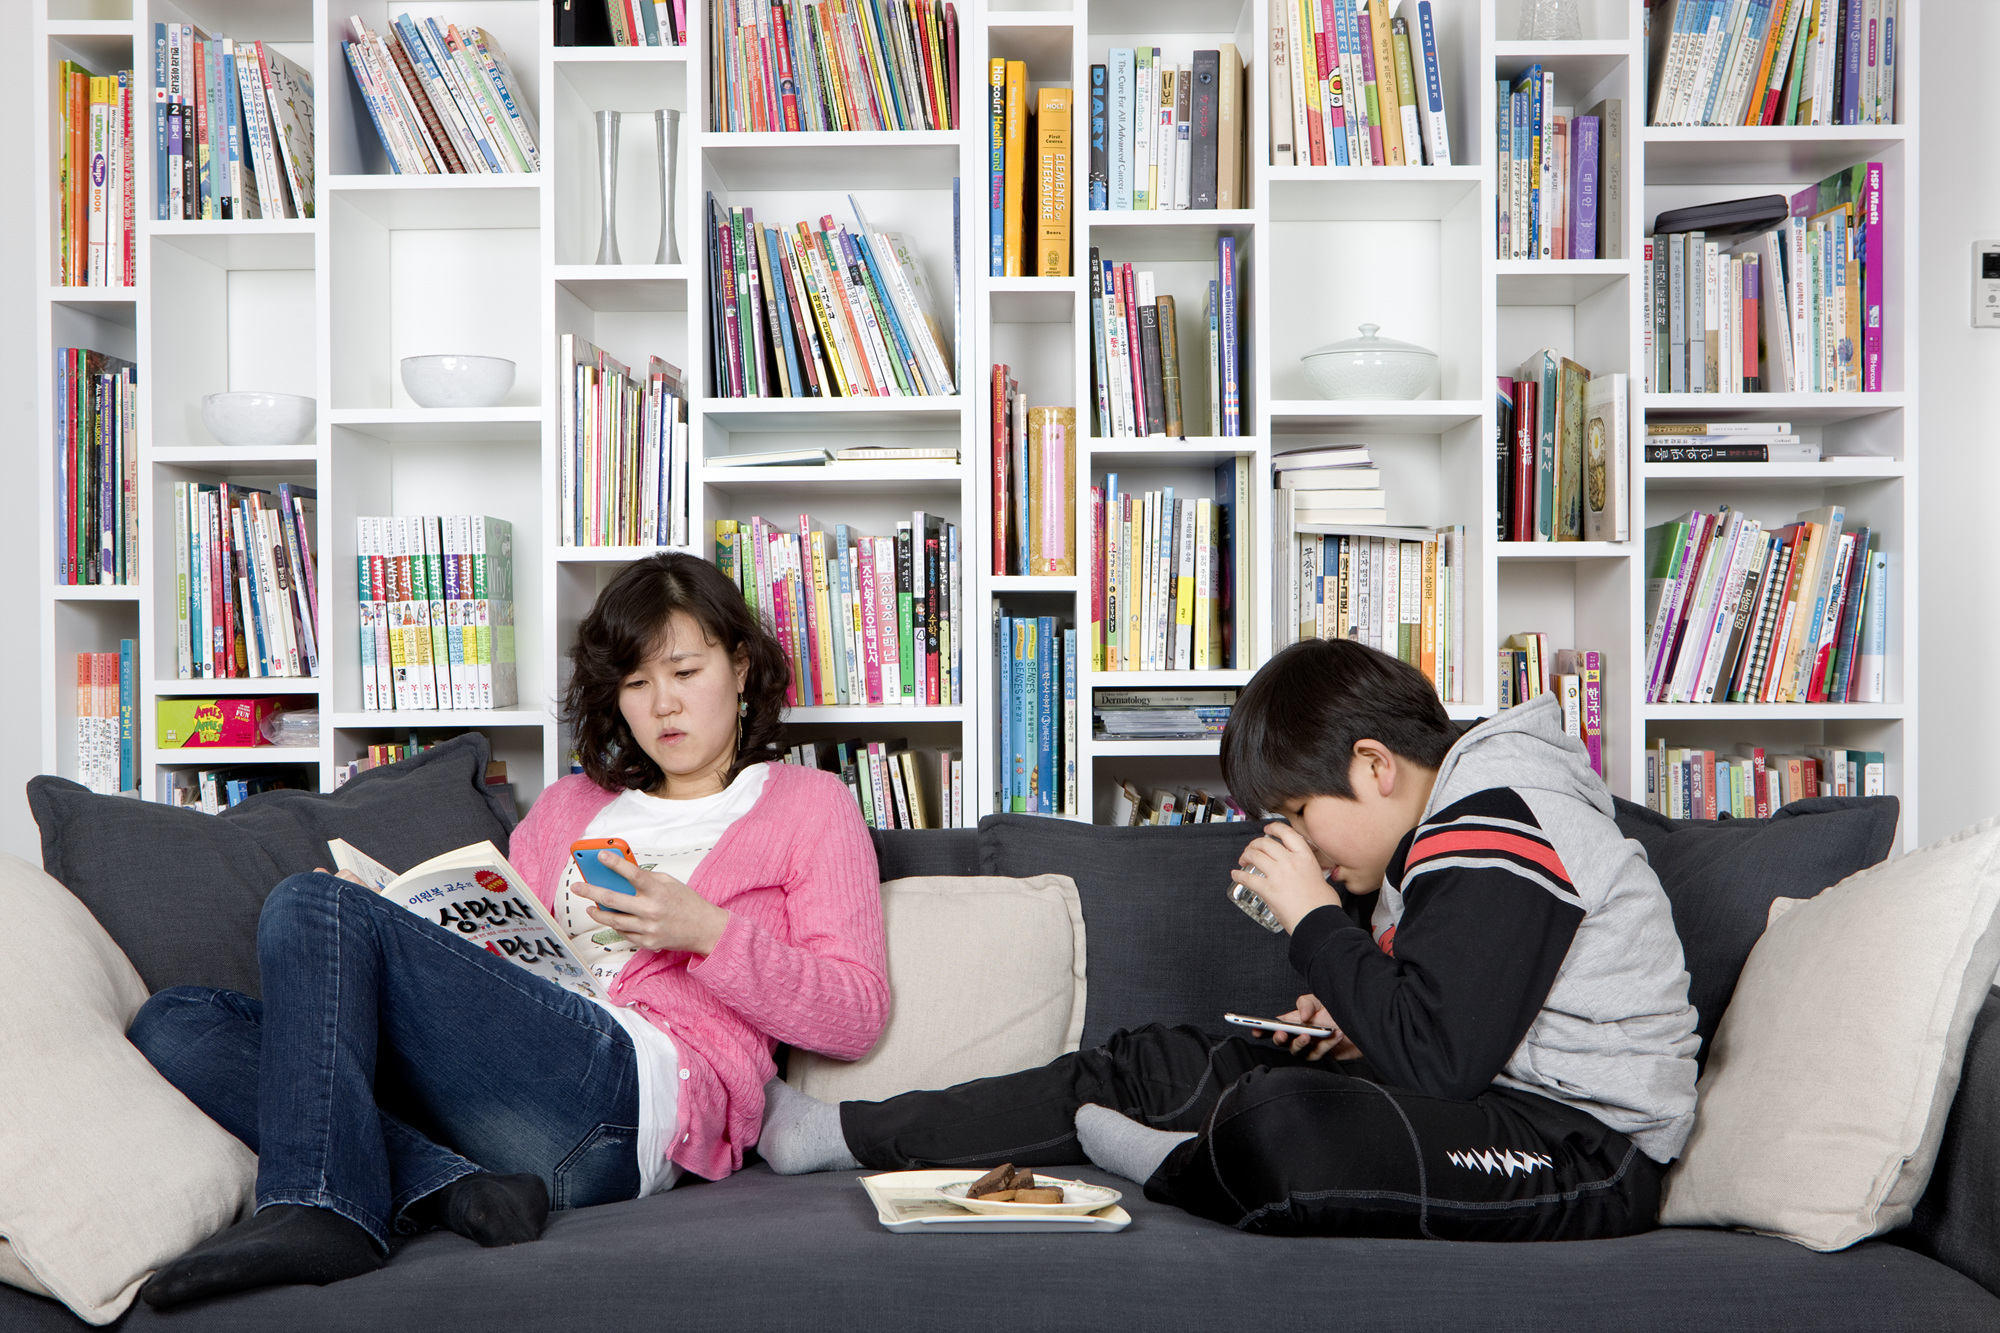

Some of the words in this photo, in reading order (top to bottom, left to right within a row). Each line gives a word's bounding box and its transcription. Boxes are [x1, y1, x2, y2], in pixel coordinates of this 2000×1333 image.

[171, 48, 179, 66] 먼나라
[1118, 60, 1126, 74] The
[171, 68, 180, 94] 이웃나라
[993, 66, 1003, 114] Harcourt
[1118, 76, 1126, 94] Cure
[171, 105, 180, 114] 2
[1093, 68, 1104, 152] DIARY
[1118, 96, 1126, 108] For
[1137, 87, 1145, 133] Handbook
[172, 117, 180, 138] 프랑스
[198, 105, 206, 127] 미국사
[1118, 111, 1126, 122] All
[993, 116, 1003, 149] Health
[1118, 124, 1126, 163] Advanced
[993, 152, 1003, 171] and
[993, 175, 1003, 209] Fitness
[1042, 155, 1053, 219] LITERATURE
[1055, 154, 1065, 210] ELEMENTS
[1582, 173, 1592, 207] 데미안
[1870, 170, 1879, 190] HSP
[1870, 191, 1879, 225] Math
[1869, 361, 1877, 390] Harcourt
[1542, 432, 1552, 473] 세계사
[1388, 542, 1397, 562] 기적은
[374, 559, 385, 595] Why?
[386, 560, 400, 599] Why?
[414, 559, 427, 595] Why?
[446, 559, 460, 594] Why?
[1388, 564, 1396, 578] 당신
[1388, 580, 1396, 593] 안에
[1388, 596, 1396, 623] 있습니다
[1739, 589, 1752, 613] 여성의
[1734, 613, 1748, 630] 건강
[916, 631, 925, 642] 4
[1015, 662, 1024, 694] SENSES
[1027, 662, 1036, 694] SENSES
[1042, 672, 1050, 694] 한국사
[1042, 695, 1050, 714] 이야기
[1102, 696, 1151, 705] Dermatology
[1588, 688, 1600, 727] 한국사
[409, 889, 443, 906] 이원복
